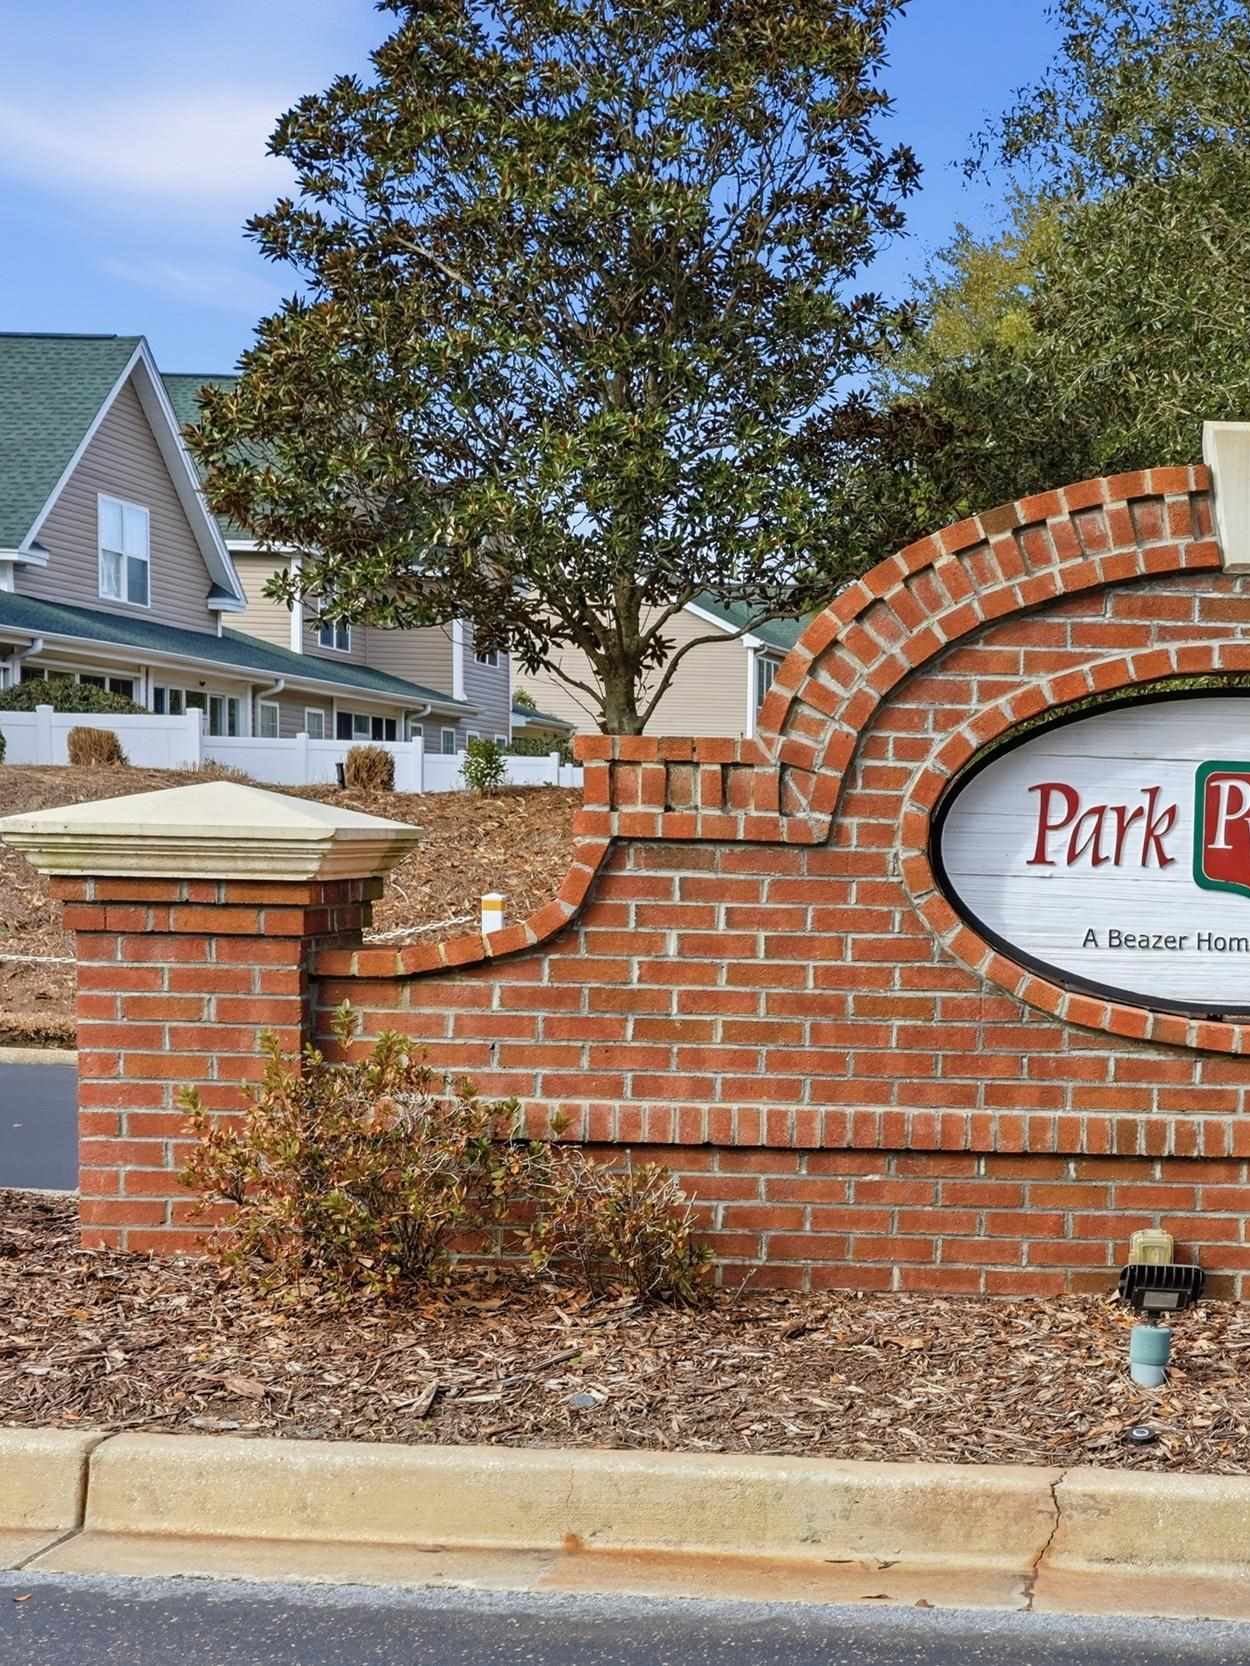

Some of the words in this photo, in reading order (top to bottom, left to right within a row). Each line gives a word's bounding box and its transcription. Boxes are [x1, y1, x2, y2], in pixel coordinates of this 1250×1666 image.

[1026, 782, 1177, 869] Park
[1082, 928, 1099, 948] A
[1108, 928, 1188, 950] Beazer
